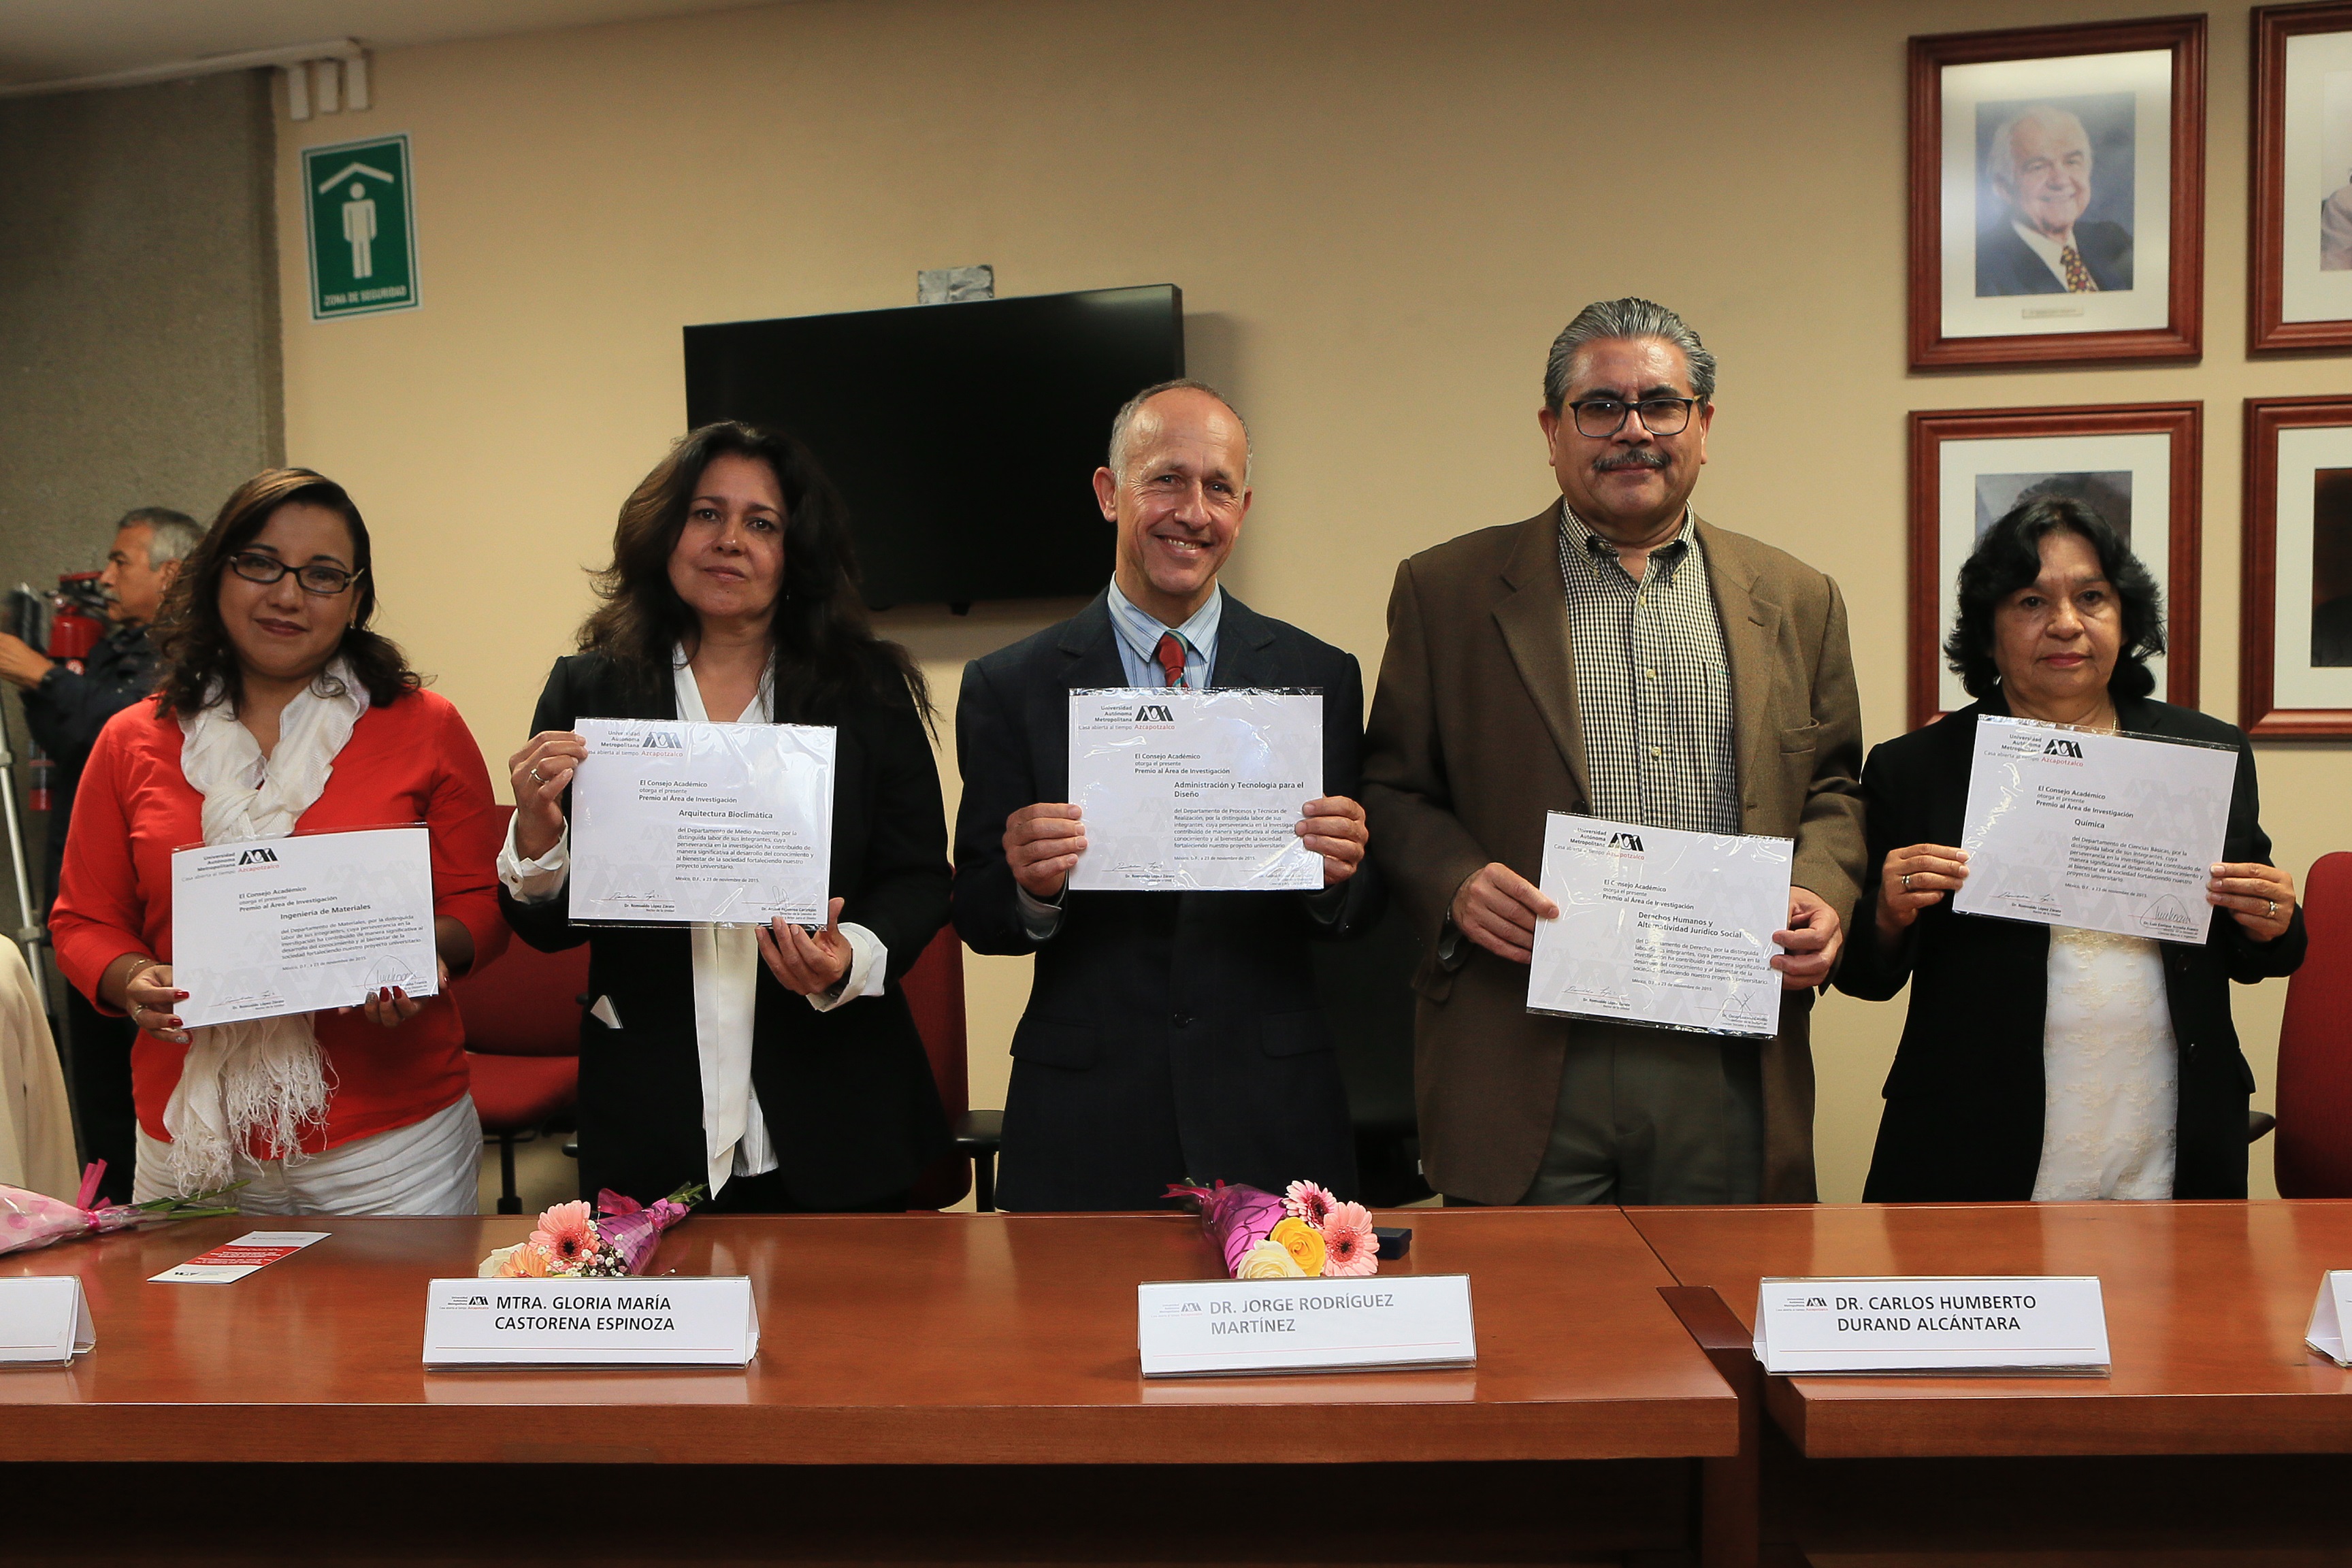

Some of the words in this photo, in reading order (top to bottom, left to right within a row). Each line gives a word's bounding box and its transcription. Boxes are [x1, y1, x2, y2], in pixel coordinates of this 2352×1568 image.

[2001, 744, 2040, 752] Metroptan
[2012, 740, 2041, 748] Autóoma
[2041, 756, 2083, 767] Azcapotzalco
[647, 779, 672, 787] Consejo
[1237, 781, 1277, 789] Tecnología
[2045, 786, 2070, 796] Consejo
[2071, 789, 2106, 800] Académico
[679, 809, 725, 818] Arquitectura
[728, 811, 772, 819] Bioclimática
[2036, 800, 2058, 808] Premio
[2092, 807, 2134, 818] Investigación
[2074, 818, 2104, 828] Química
[1605, 850, 1644, 860] Azpotzalco
[238, 864, 280, 872] Azcapotzalco
[1610, 880, 1633, 889] Cnsejo
[1634, 883, 1666, 892] Académico
[296, 896, 338, 904] Investigación
[331, 904, 371, 913] Materiales
[1672, 915, 1706, 926] Humanos
[1637, 921, 1688, 932] Altentividad
[1690, 927, 1718, 936] Jurídico
[1720, 930, 1742, 938] Social
[497, 1296, 546, 1309] MTRA.
[553, 1296, 612, 1310] GLORIA
[617, 1294, 671, 1310] MARÍA
[1210, 1301, 1237, 1314] DR.
[1242, 1298, 1294, 1313] JORGE
[1299, 1292, 1394, 1311] RODRÍGUEZ
[1835, 1297, 1863, 1310] DR.
[1868, 1296, 1935, 1310] CARLOS
[1940, 1295, 2036, 1309] HUMBERTO
[495, 1316, 591, 1330] CASTORENA
[597, 1317, 675, 1330] ESPINOZA
[1211, 1316, 1296, 1335] MARTÍNEZ
[1838, 1318, 1911, 1331] DURAND
[1916, 1313, 2021, 1331] ALCÁNTARA
